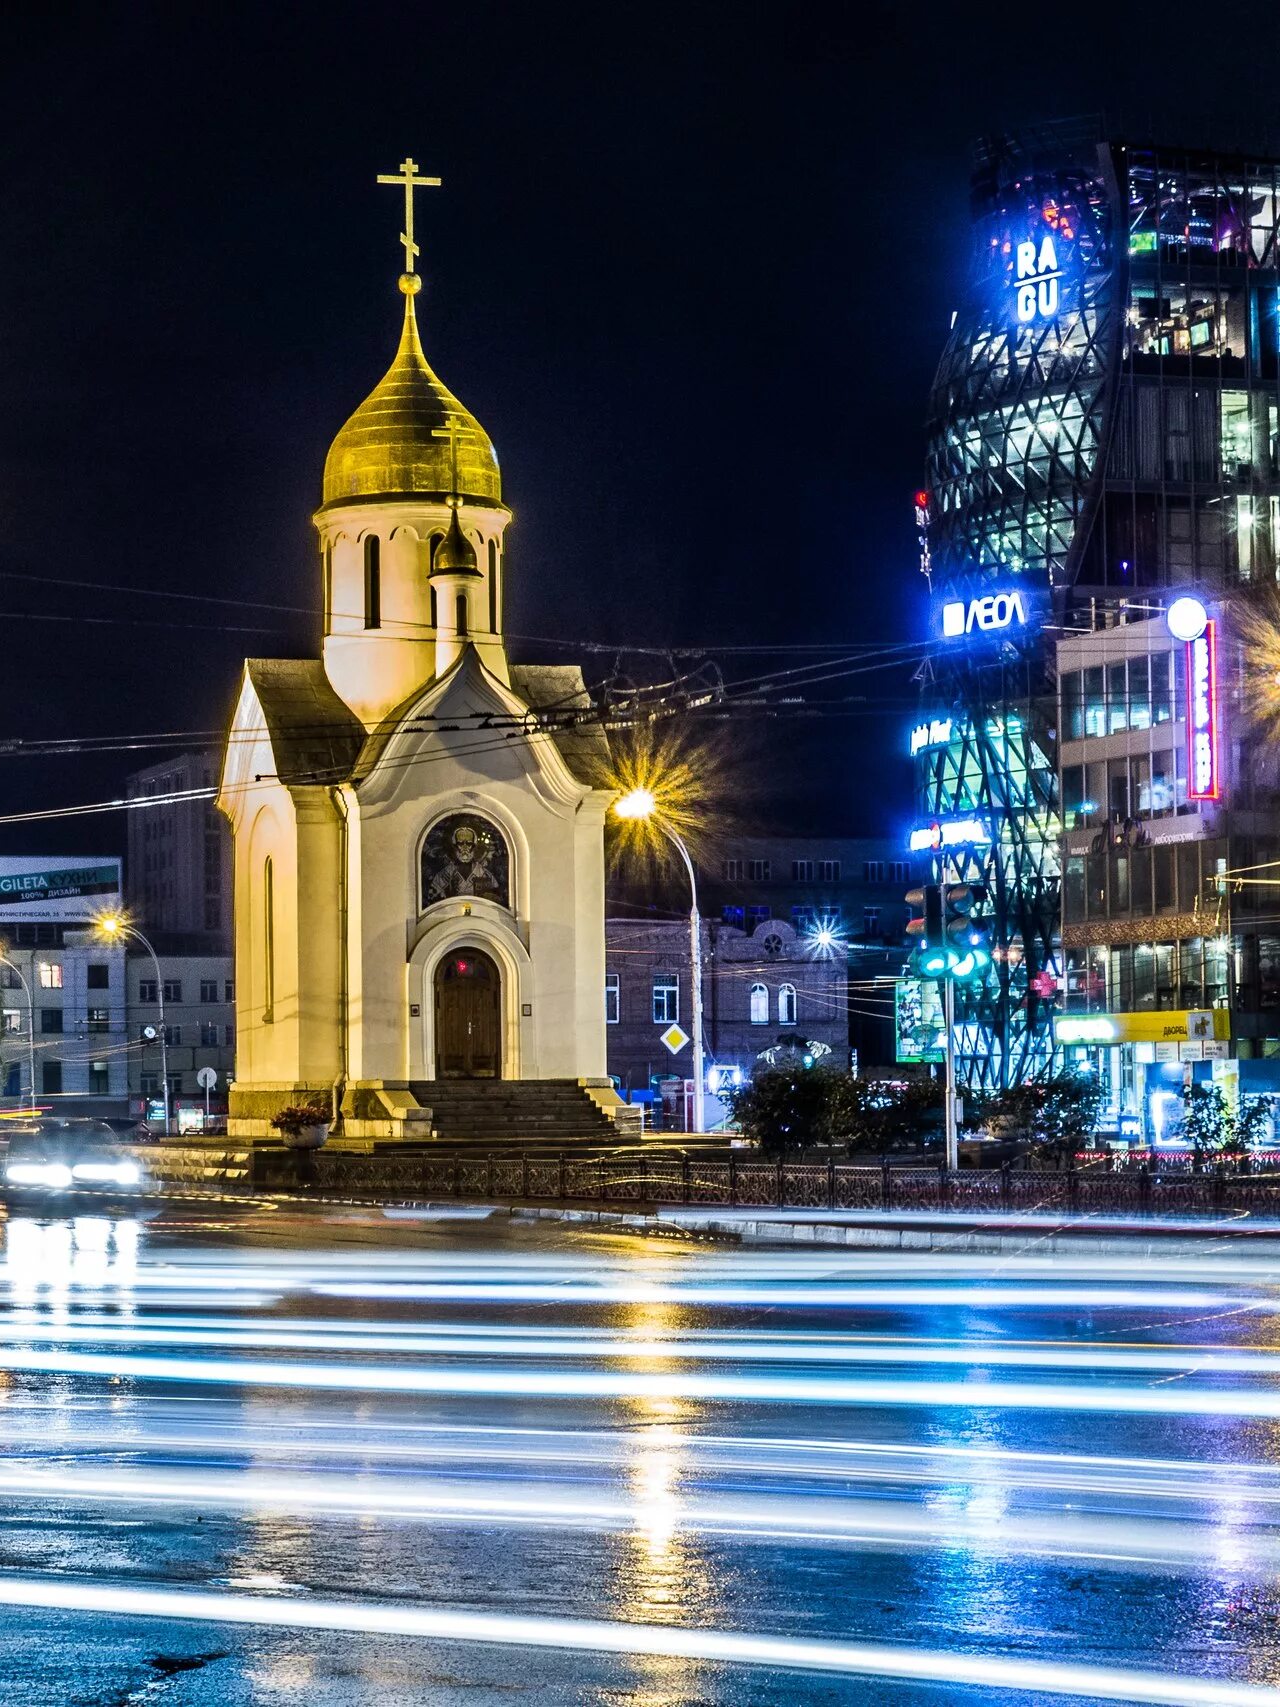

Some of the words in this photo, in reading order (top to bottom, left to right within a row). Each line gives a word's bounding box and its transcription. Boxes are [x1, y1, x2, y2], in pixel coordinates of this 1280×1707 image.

[1017, 236, 1058, 279] RA
[1017, 278, 1058, 321] GU
[0, 875, 48, 892] GILETA
[48, 870, 98, 888] КУХНИ
[20, 892, 45, 900] 100%
[47, 886, 81, 899] ДИЗАЙН
